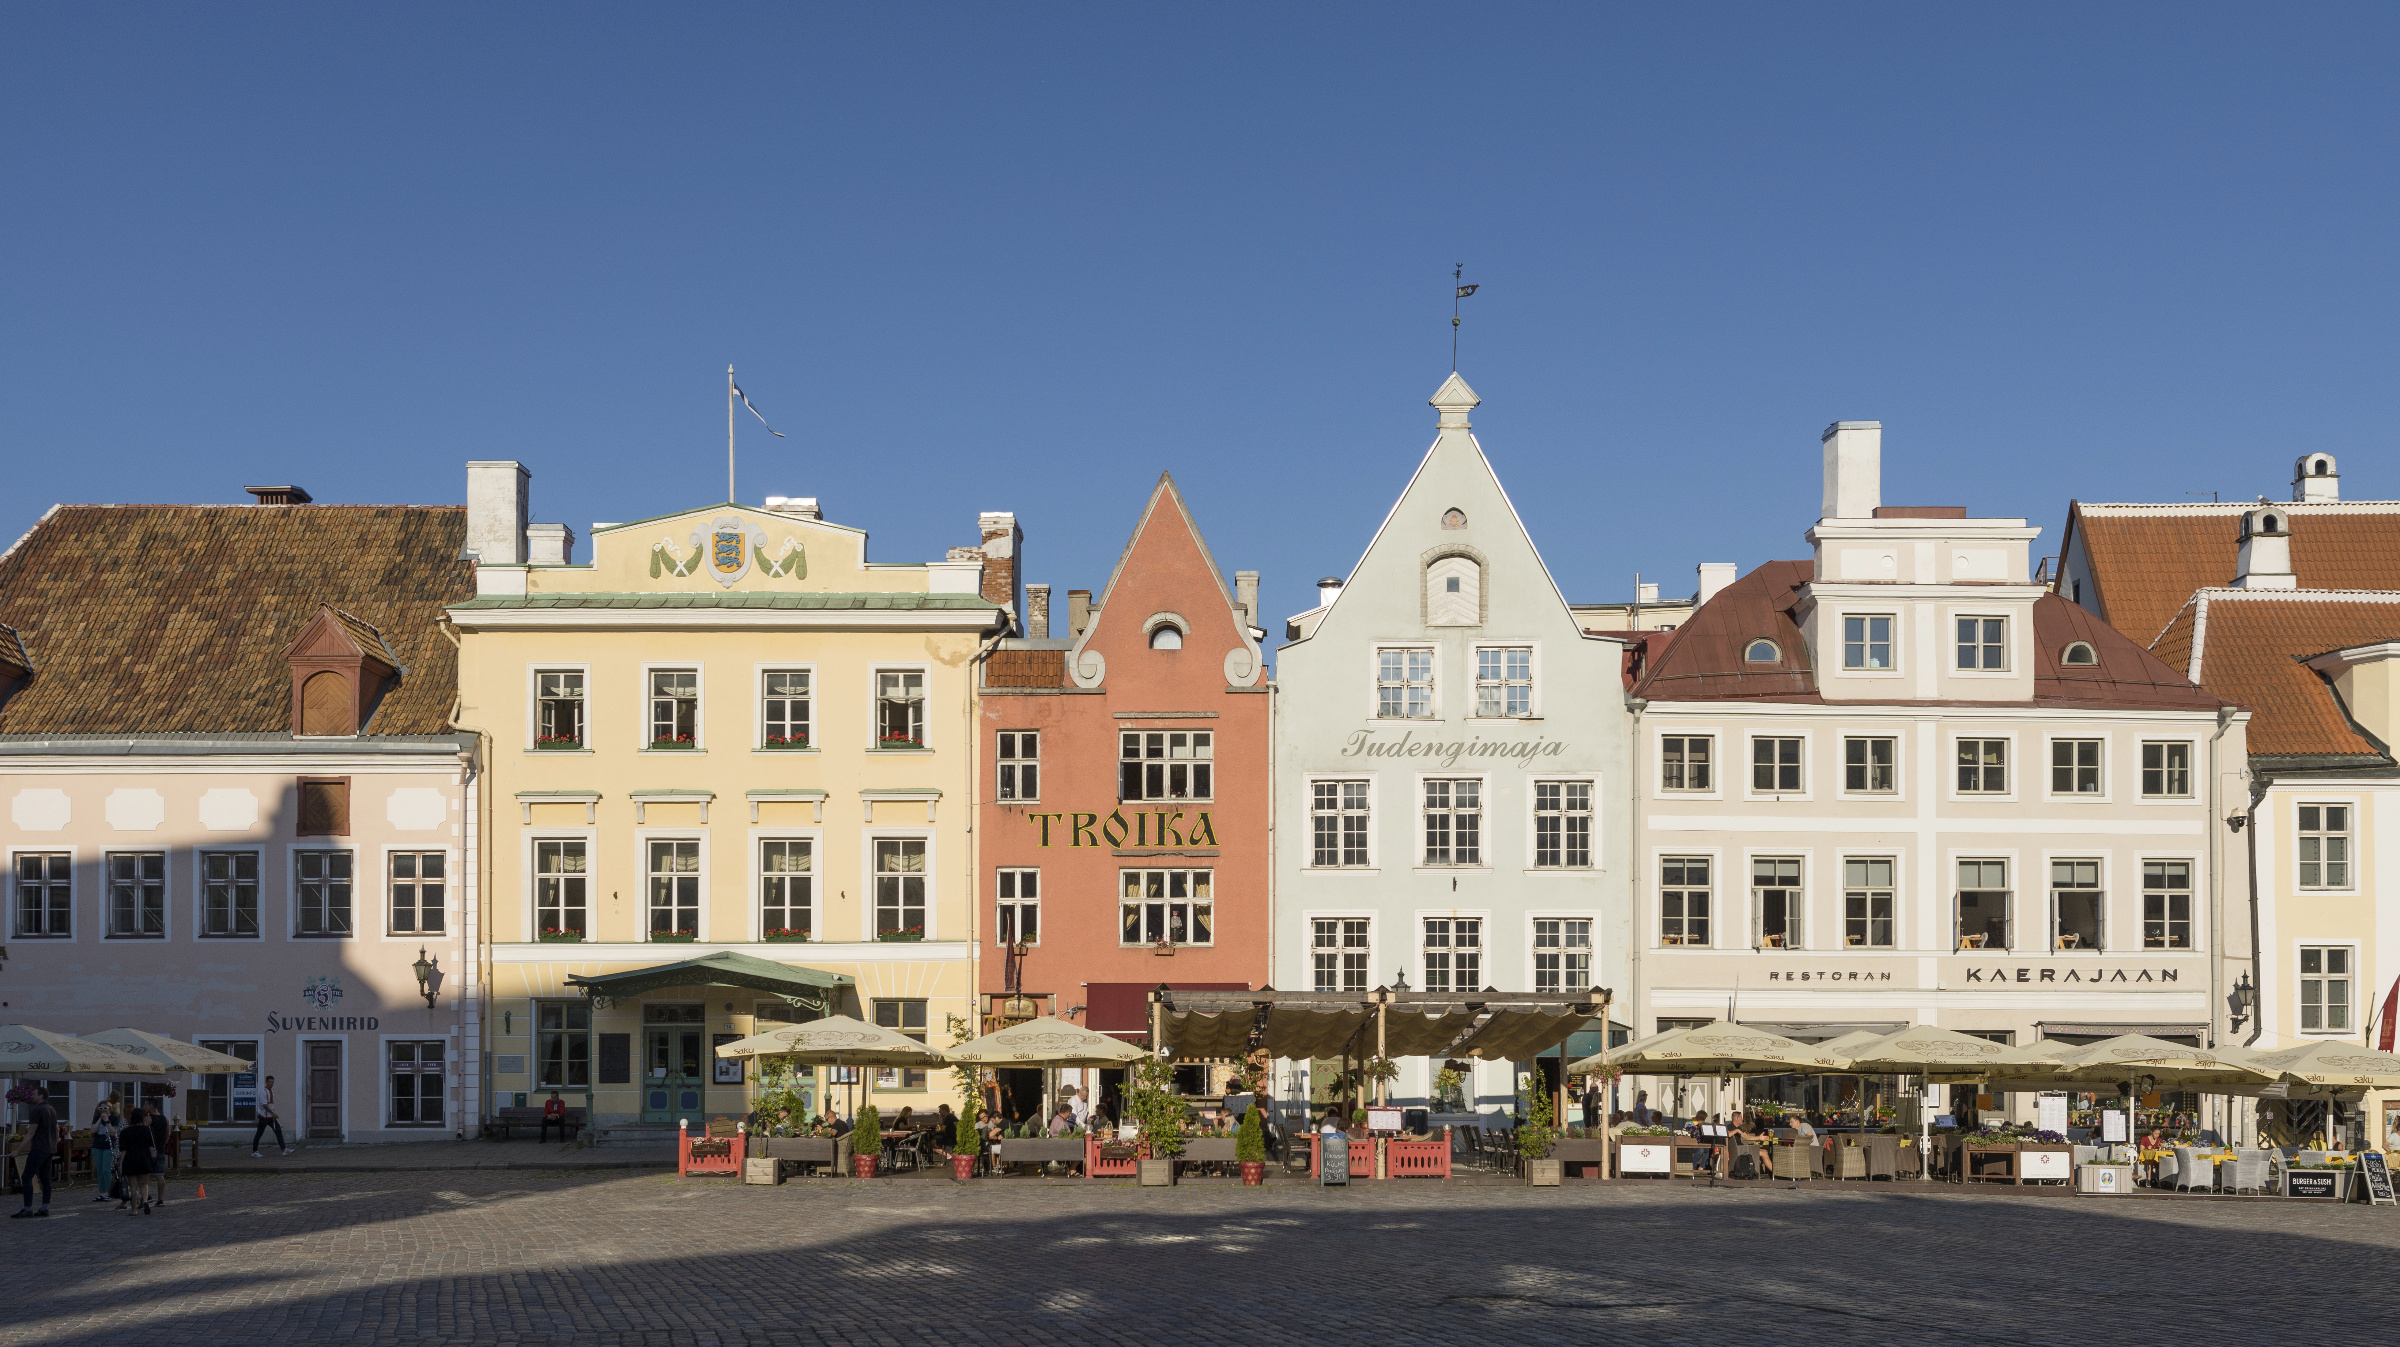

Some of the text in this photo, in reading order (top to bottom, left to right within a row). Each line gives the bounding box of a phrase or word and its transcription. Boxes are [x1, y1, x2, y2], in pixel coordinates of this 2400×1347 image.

[1341, 729, 1570, 769] Tudengimaja
[1028, 806, 1220, 850] TROIKA
[1769, 971, 1891, 982] RESTORAN
[1966, 968, 2179, 983] KAERAJAAN
[961, 1052, 982, 1060] saku
[1013, 1052, 1034, 1060] saku
[28, 1061, 50, 1070] saku
[1814, 1057, 1834, 1066] saku
[2305, 1073, 2325, 1082] saku
[2354, 1074, 2373, 1083] saku
[2292, 1177, 2313, 1185] BURGER
[2317, 1178, 2332, 1186] SUSHI
